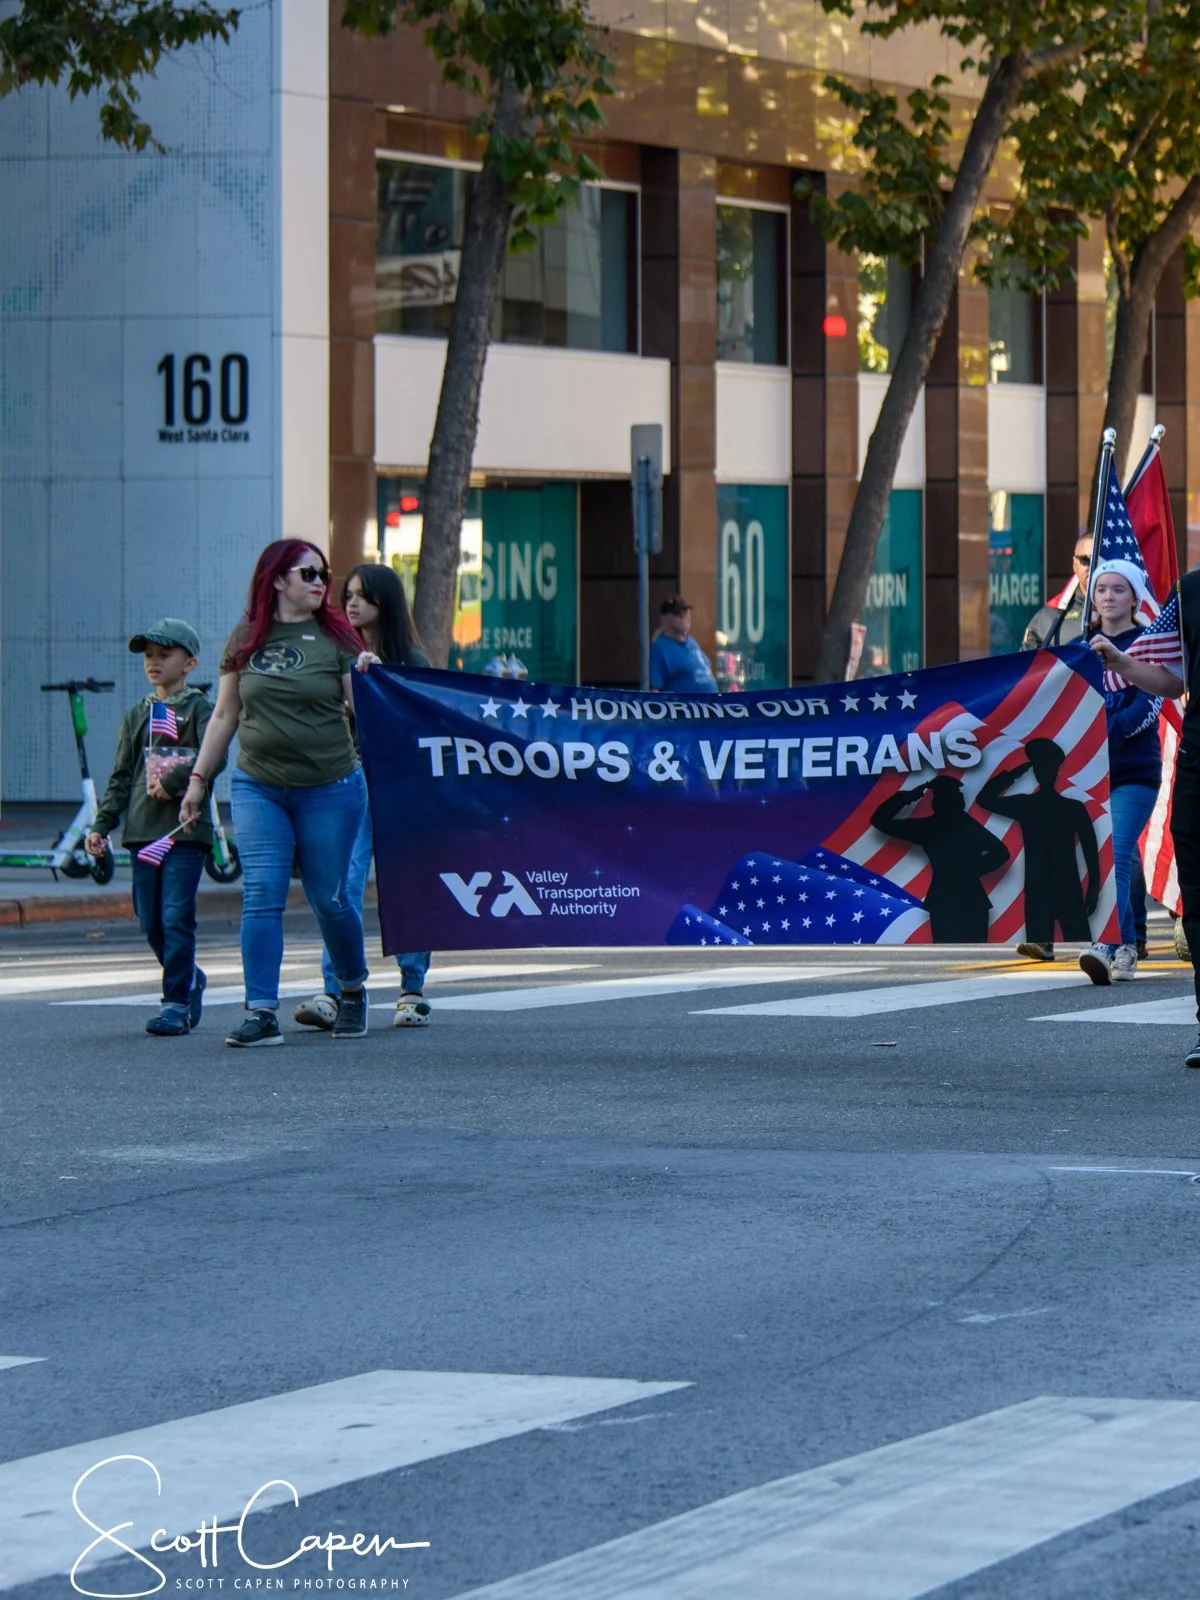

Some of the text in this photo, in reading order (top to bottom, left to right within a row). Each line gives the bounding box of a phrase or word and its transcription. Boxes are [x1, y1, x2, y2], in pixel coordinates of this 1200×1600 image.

[157, 352, 249, 426] 160
[158, 429, 249, 442] West Santa Clara
[493, 627, 533, 649] SPACE
[570, 697, 830, 721] HONORING OUR
[418, 729, 983, 783] TROOPS & VETERANS
[526, 871, 569, 886] Valley
[536, 885, 641, 901] Transportation
[550, 902, 618, 918] Authority
